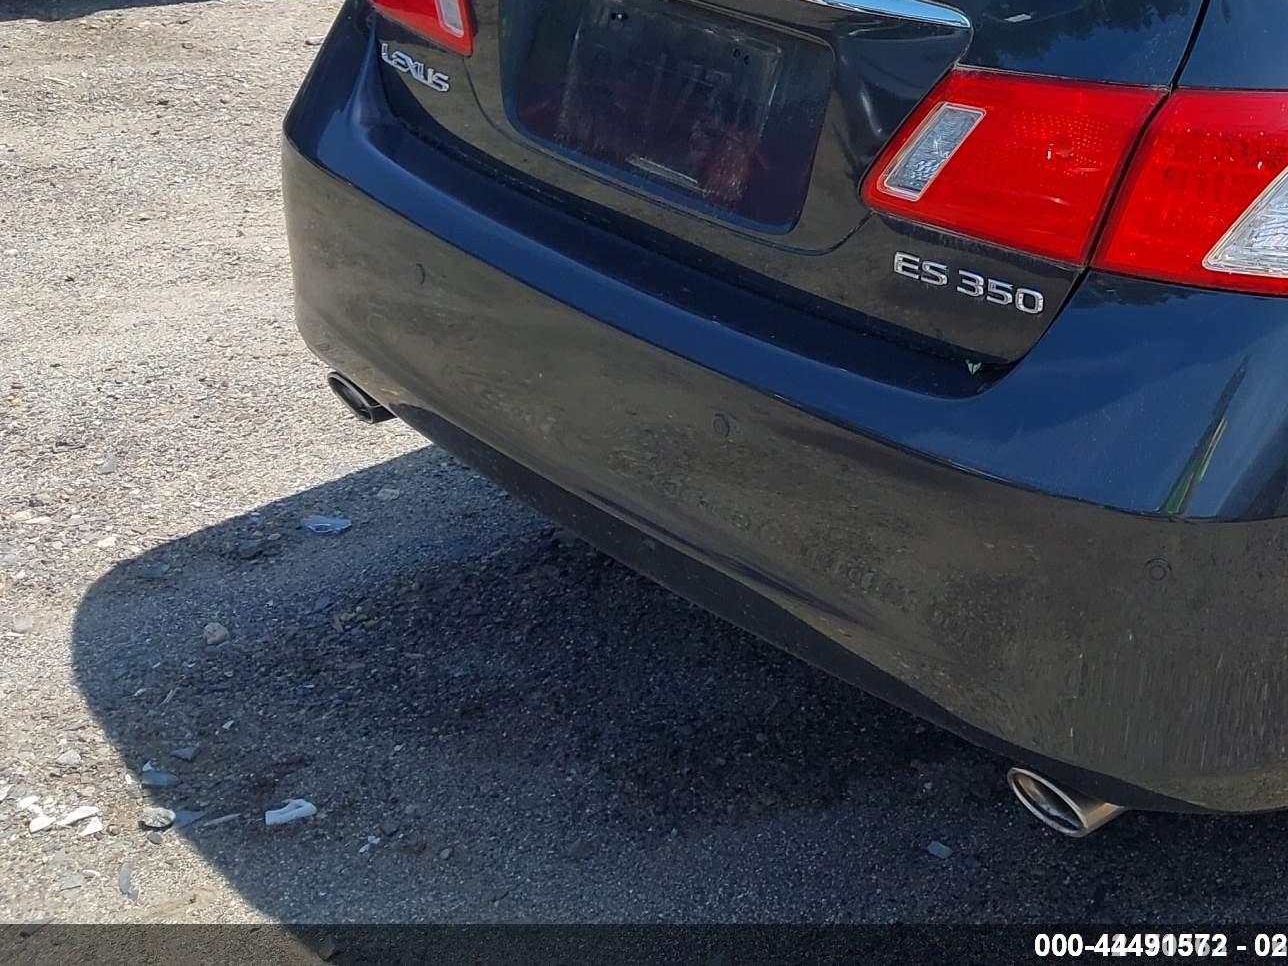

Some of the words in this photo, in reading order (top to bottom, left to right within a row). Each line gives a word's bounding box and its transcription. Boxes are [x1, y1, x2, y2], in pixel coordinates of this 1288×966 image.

[381, 42, 450, 92] LEXUS
[893, 251, 949, 286] ES
[956, 269, 1045, 314] 350
